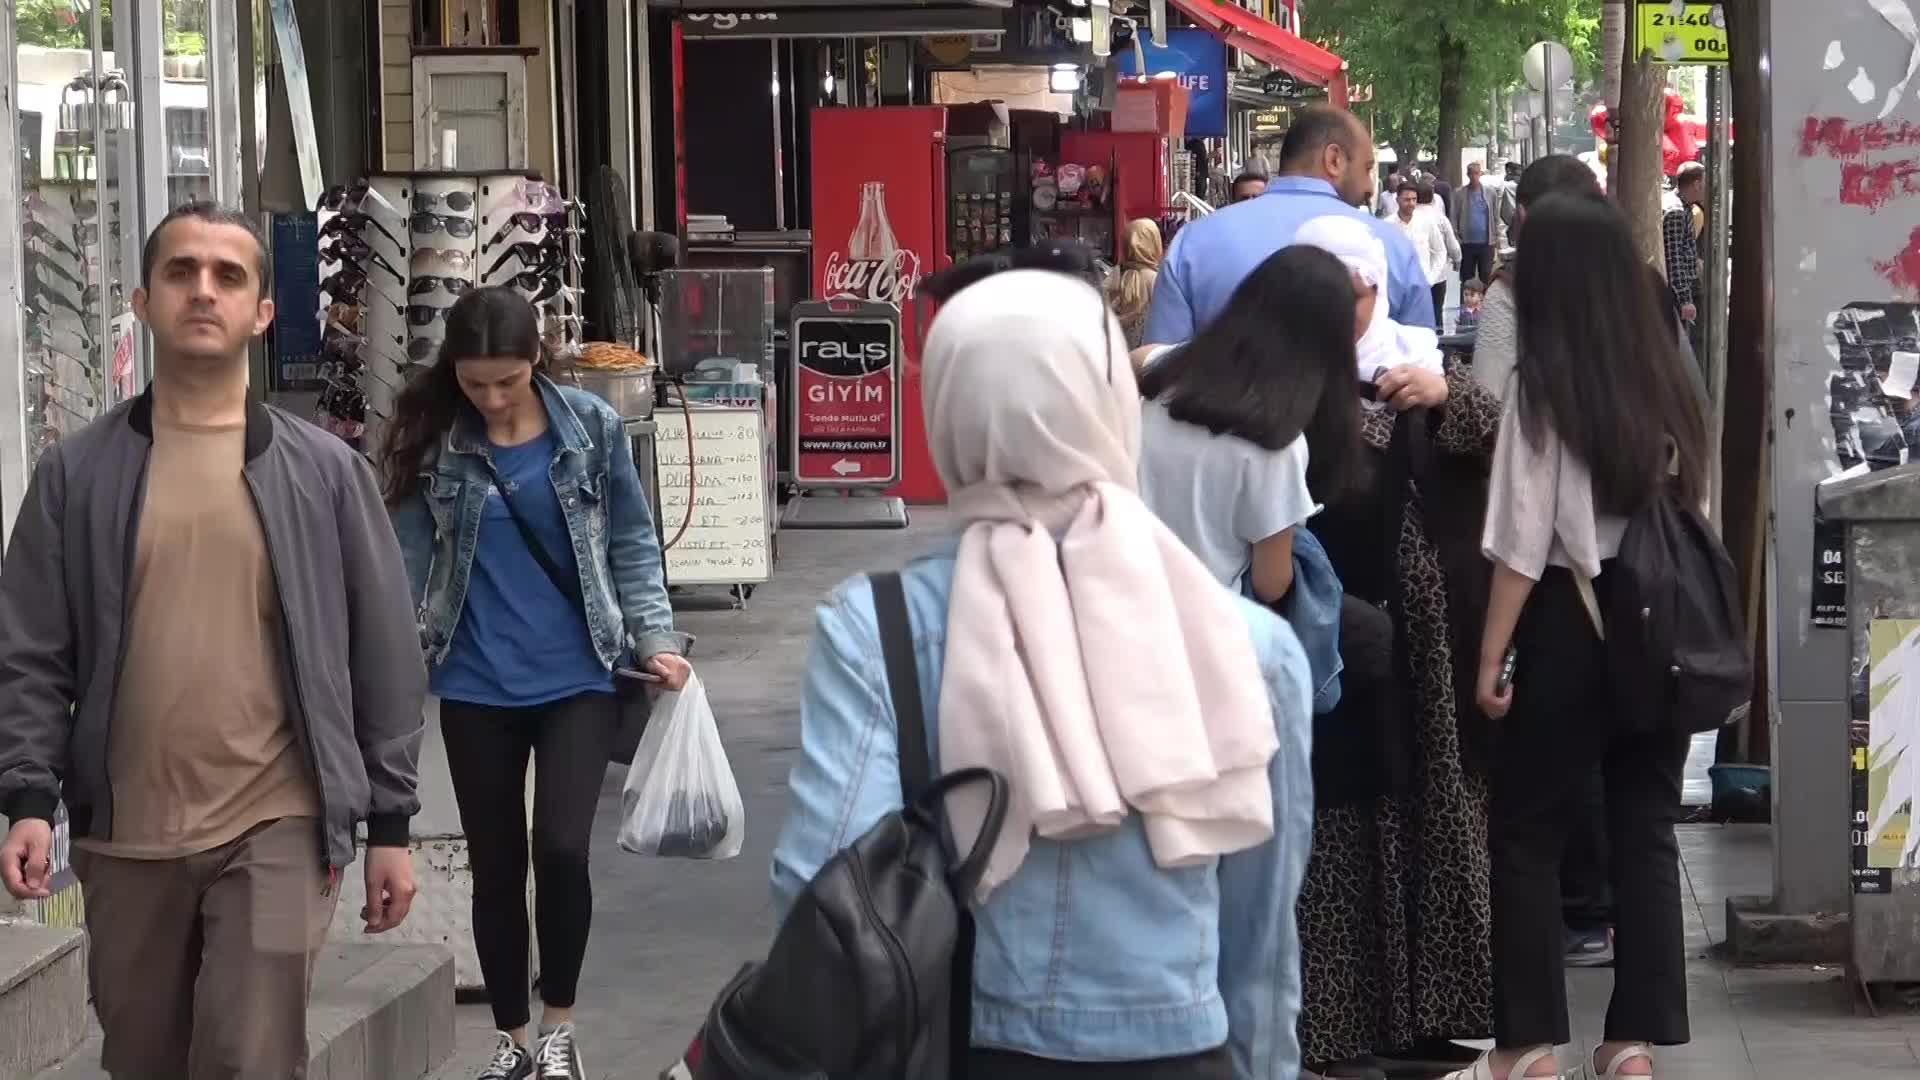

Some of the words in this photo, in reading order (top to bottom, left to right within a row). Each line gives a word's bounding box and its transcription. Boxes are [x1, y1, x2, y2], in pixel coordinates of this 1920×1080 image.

[801, 341, 887, 374] rays
[808, 381, 882, 402] GİYİM
[1823, 550, 1841, 564] 04
